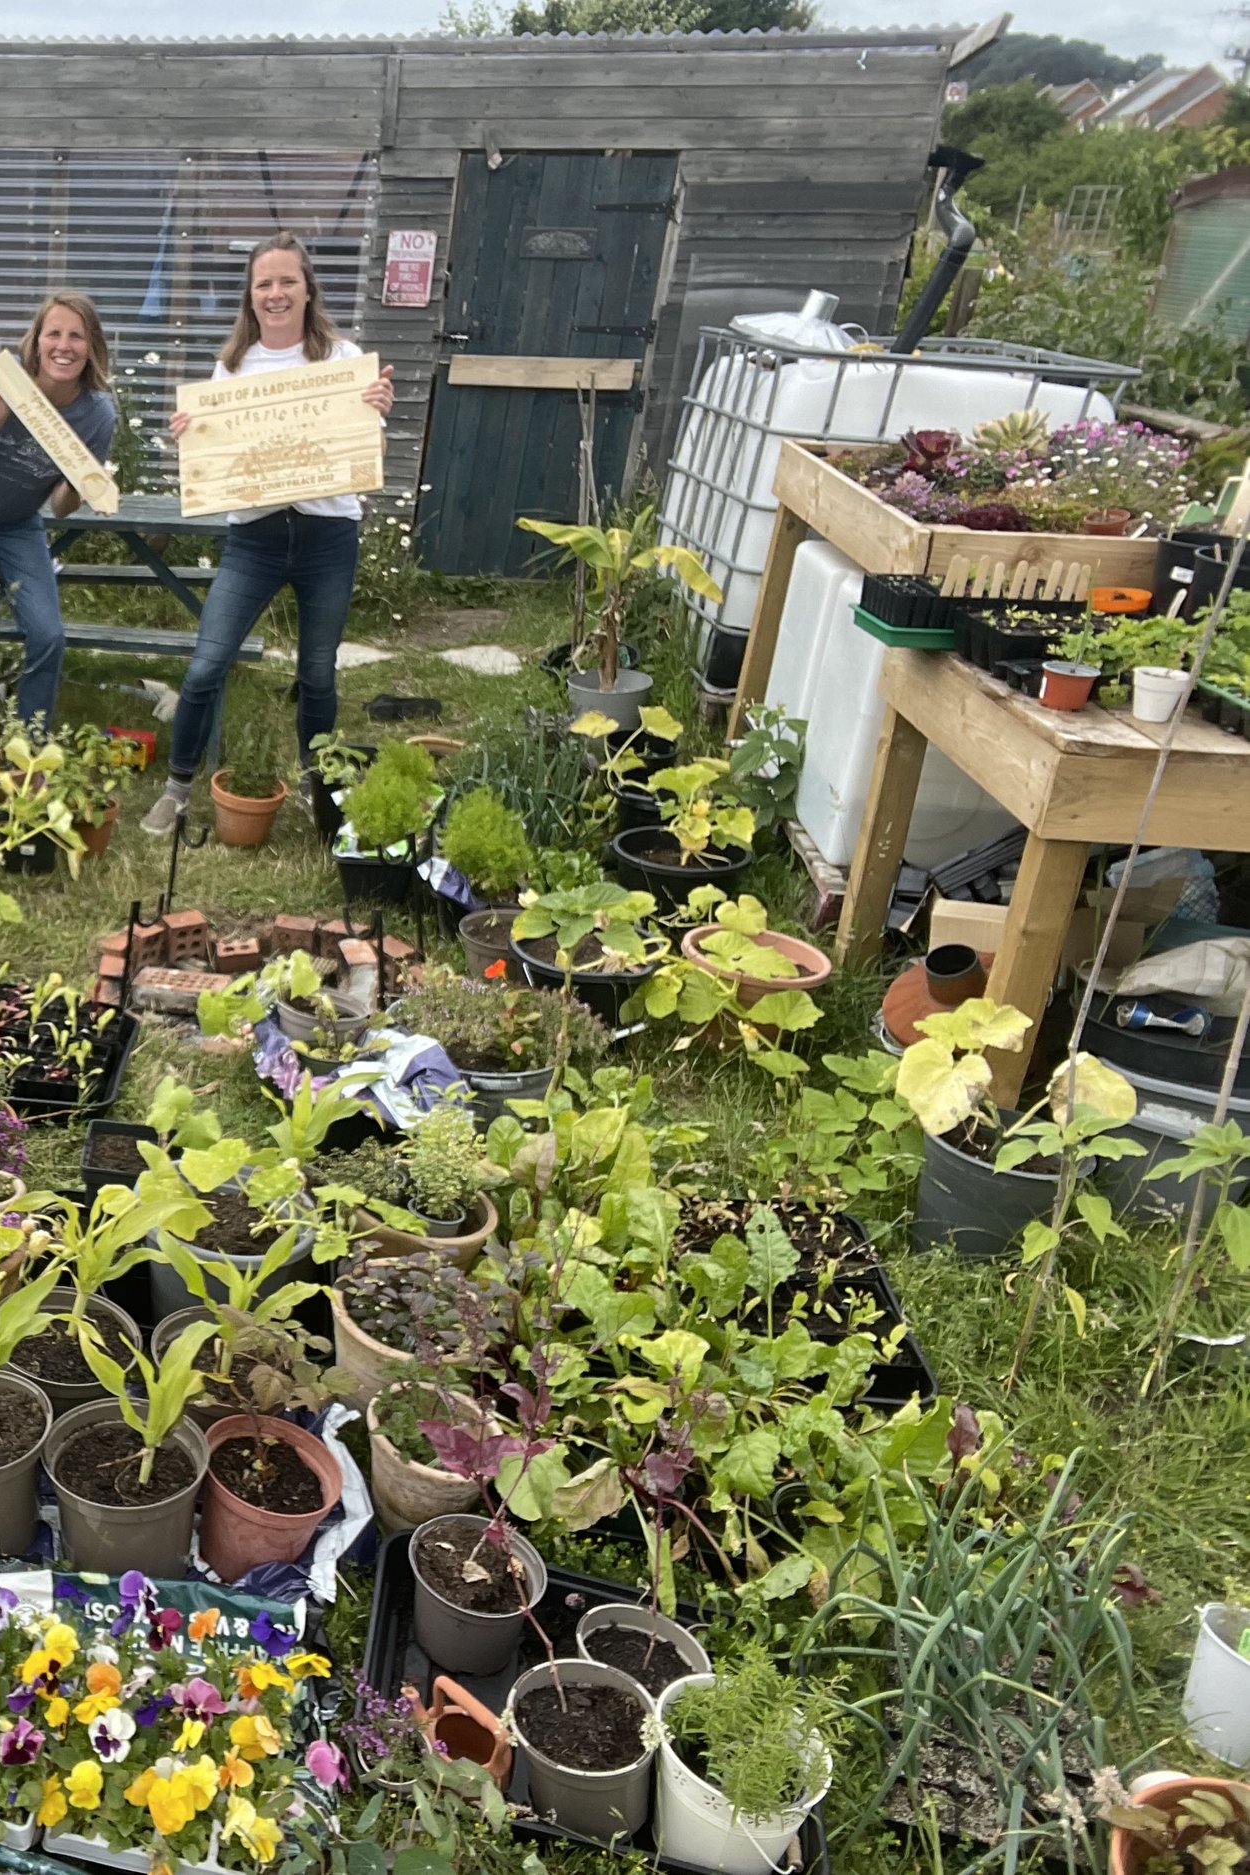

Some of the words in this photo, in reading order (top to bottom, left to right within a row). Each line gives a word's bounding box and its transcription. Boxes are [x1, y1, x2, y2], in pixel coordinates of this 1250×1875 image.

[400, 234, 425, 249] NO
[234, 388, 248, 401] OF
[252, 386, 261, 399] A
[224, 407, 287, 429] PLASTIC
[292, 399, 330, 418] FREE
[69, 441, 90, 465] OUR
[233, 1617, 250, 1638] &
